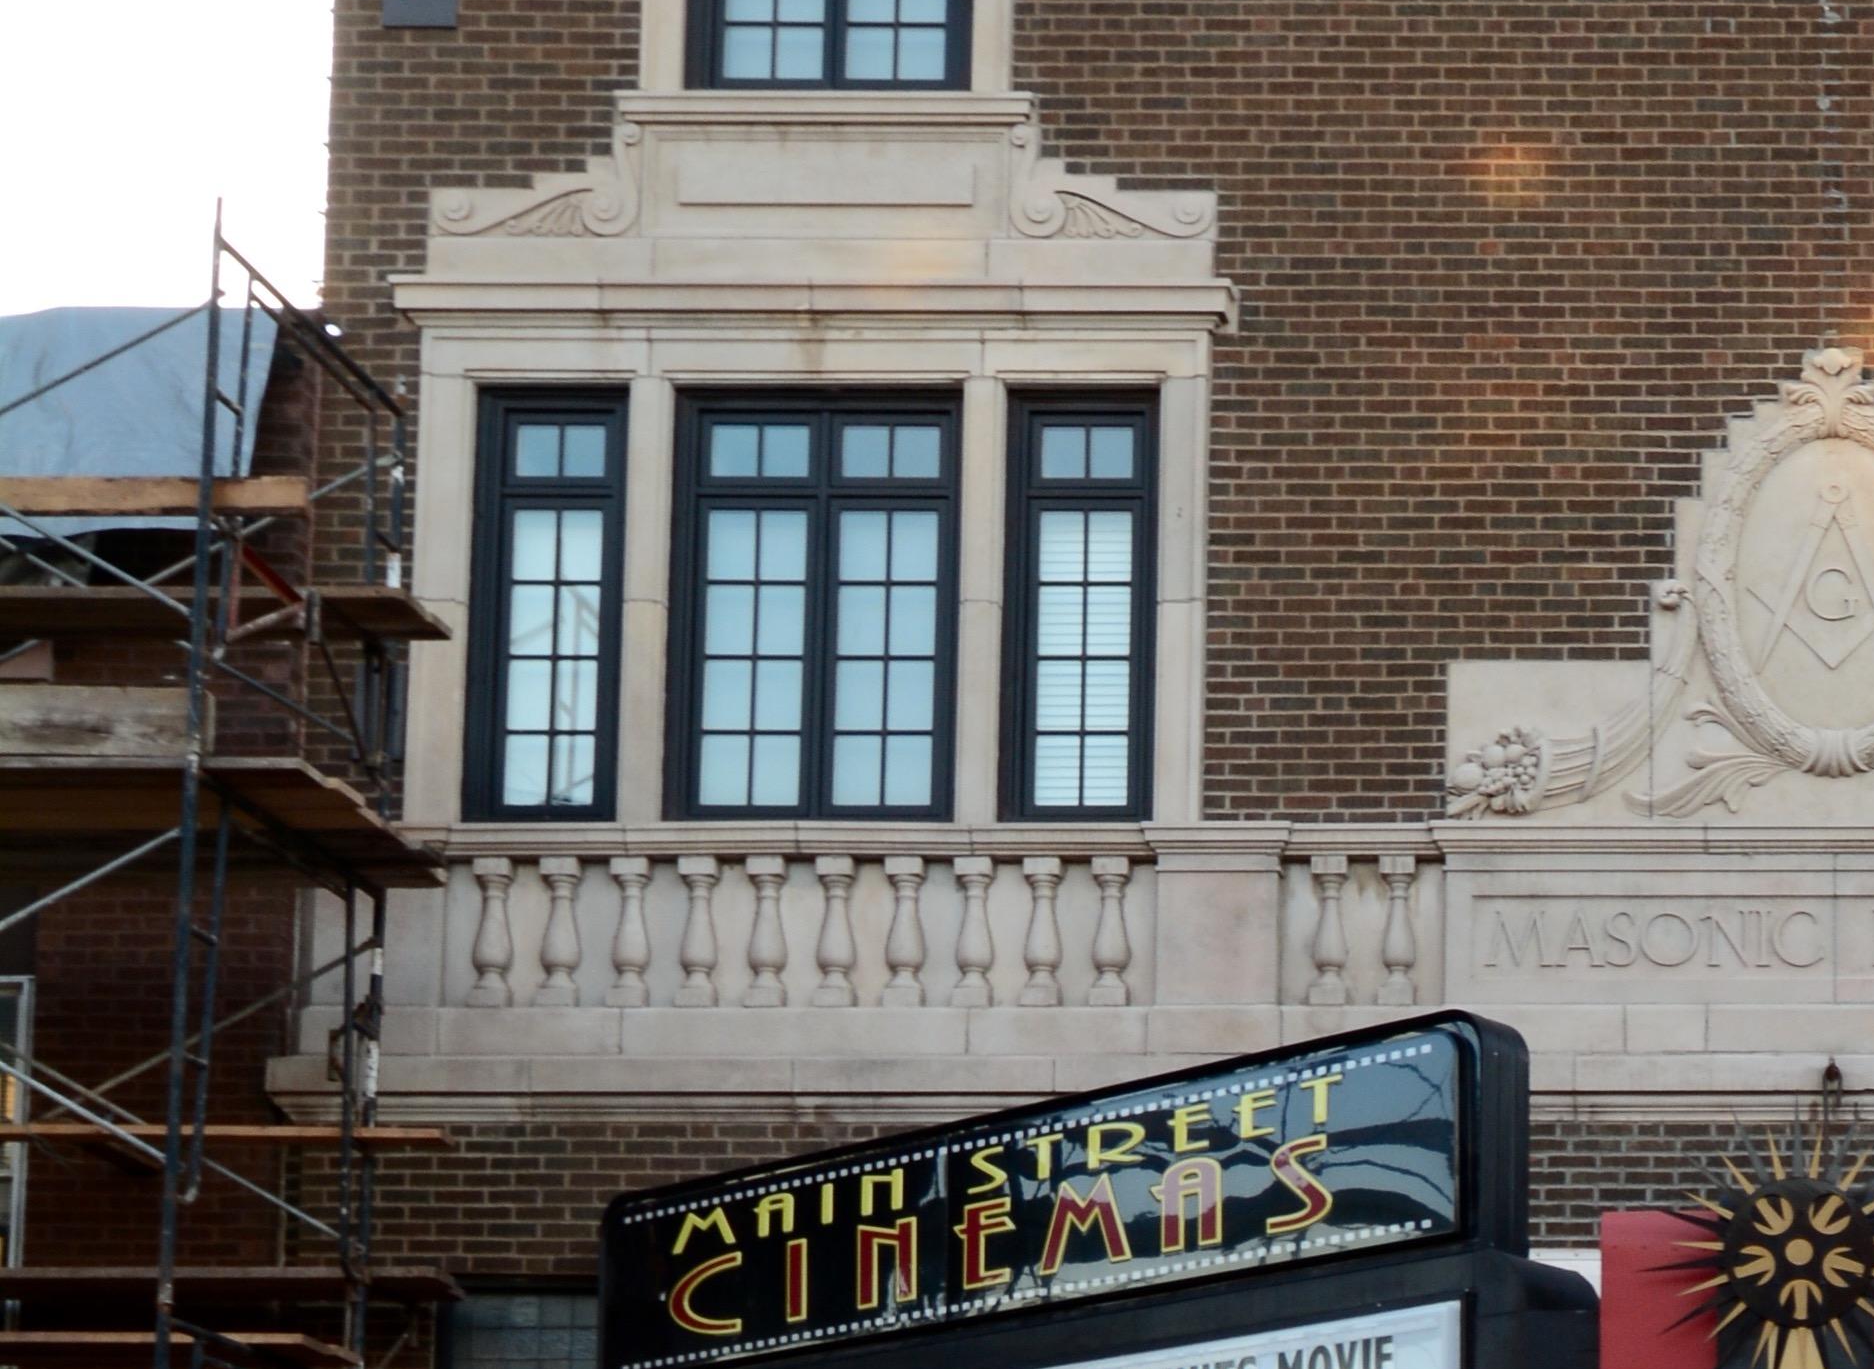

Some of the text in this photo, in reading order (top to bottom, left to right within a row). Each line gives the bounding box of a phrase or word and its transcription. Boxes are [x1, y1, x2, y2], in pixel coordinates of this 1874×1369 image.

[1805, 568, 1858, 622] G
[1484, 909, 1825, 969] MASONIC
[672, 1074, 1343, 1255] MAIN STREET
[669, 1133, 1334, 1335] CINEMAS
